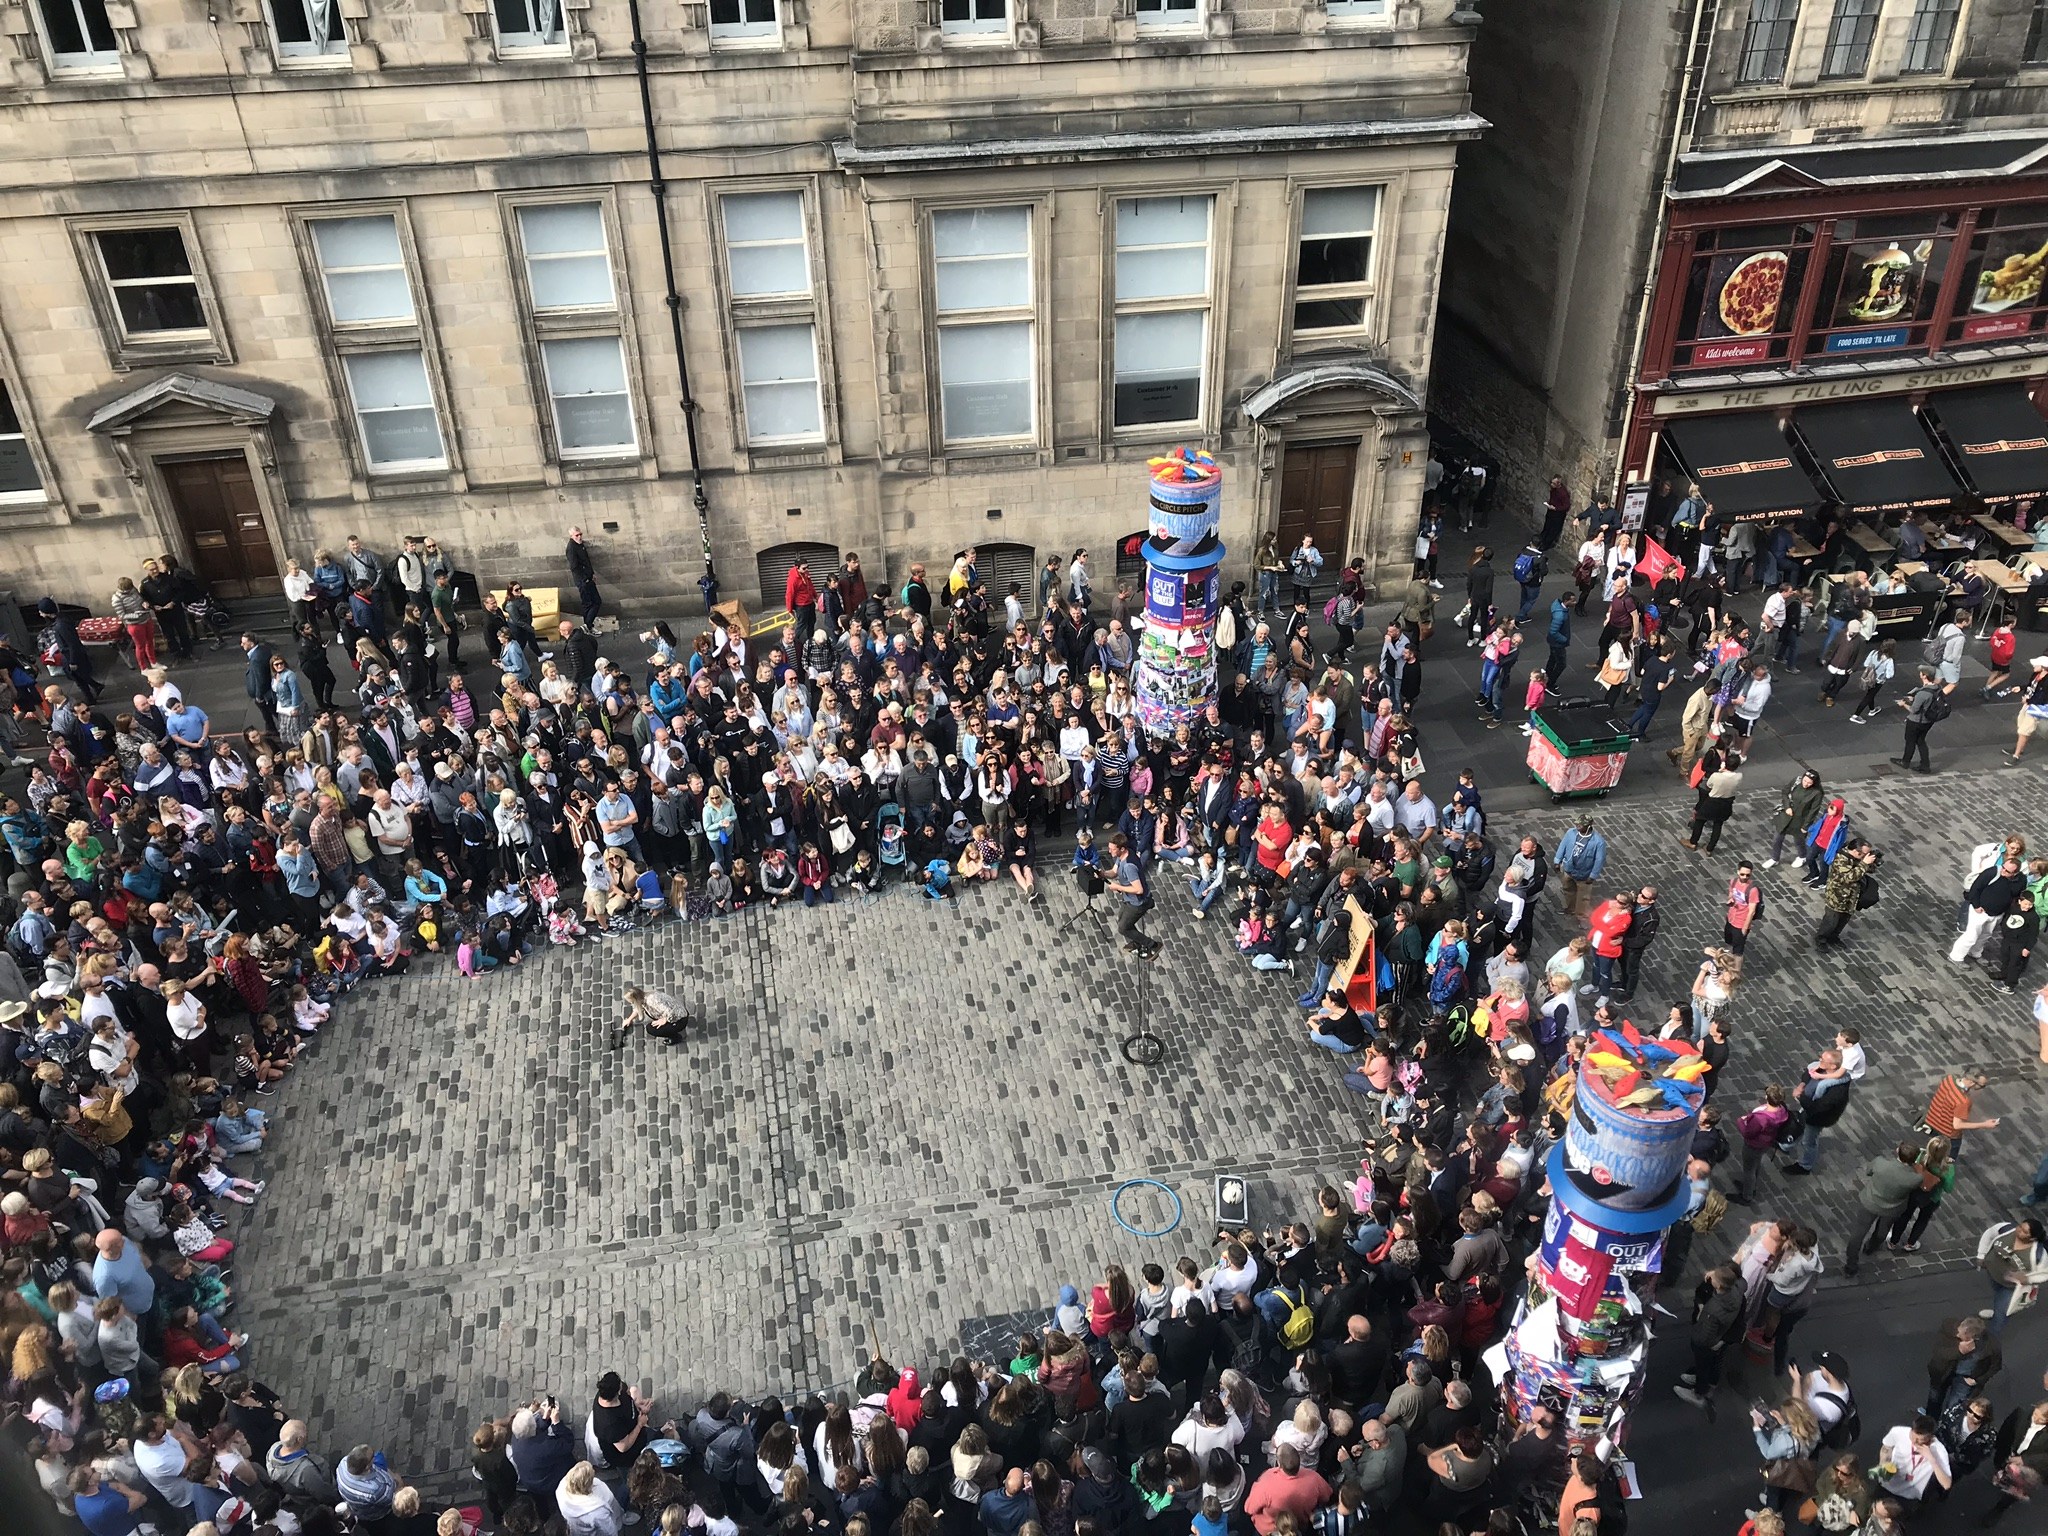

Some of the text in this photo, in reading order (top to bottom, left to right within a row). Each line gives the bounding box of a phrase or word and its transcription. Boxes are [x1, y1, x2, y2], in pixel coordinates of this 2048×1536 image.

[1838, 338, 1852, 347] FOOD
[1853, 336, 1872, 345] SERVED
[1883, 334, 1897, 343] LATE
[1705, 346, 1755, 359] Kids welcome
[1723, 391, 1769, 406] THE
[1792, 380, 1882, 400] FILLING
[1906, 367, 1994, 388] STATION
[1160, 502, 1181, 512] CIRCLE
[1882, 502, 1908, 510] PASTA
[1914, 498, 1951, 507] BURGERS
[1735, 508, 1803, 522] FILLING STATION
[1154, 580, 1173, 592] OUT
[1609, 1244, 1646, 1257] OUT
